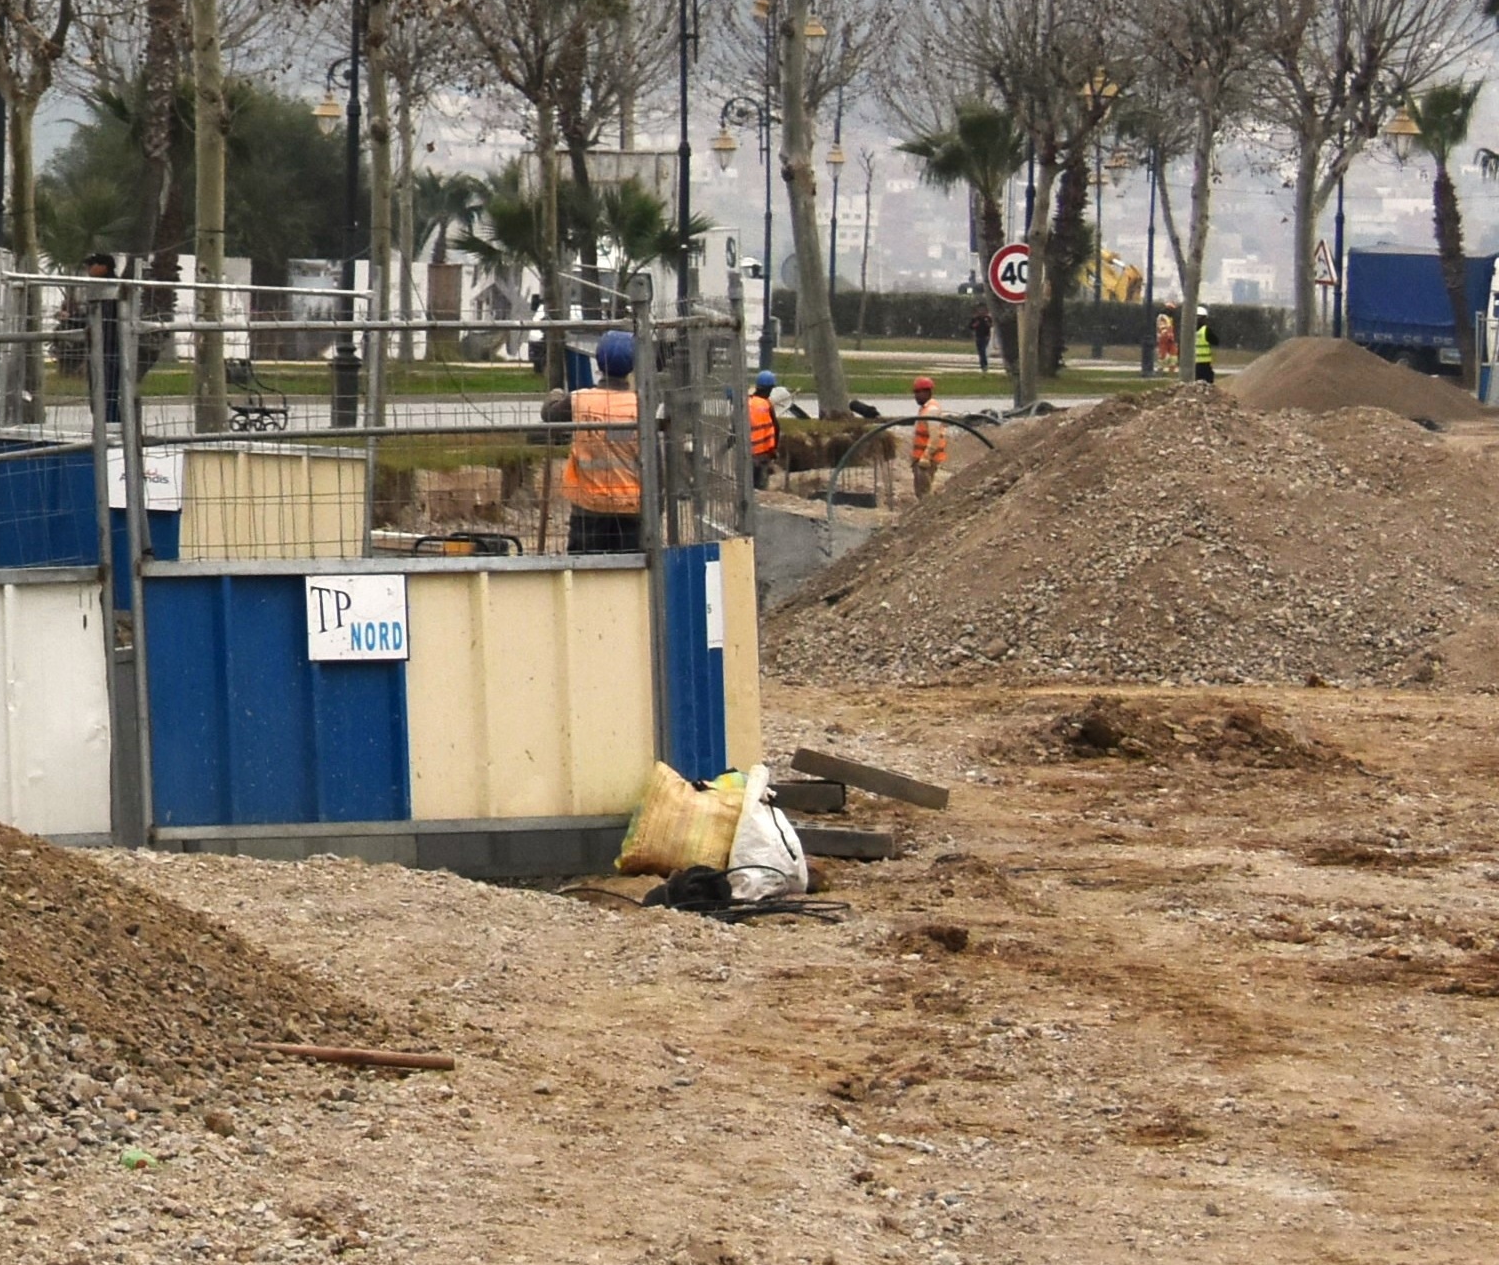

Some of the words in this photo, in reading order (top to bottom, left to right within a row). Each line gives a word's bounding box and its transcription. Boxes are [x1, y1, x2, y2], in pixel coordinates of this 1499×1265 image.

[1001, 261, 1028, 285] 40
[310, 586, 351, 634] TP
[350, 621, 403, 651] NORD
